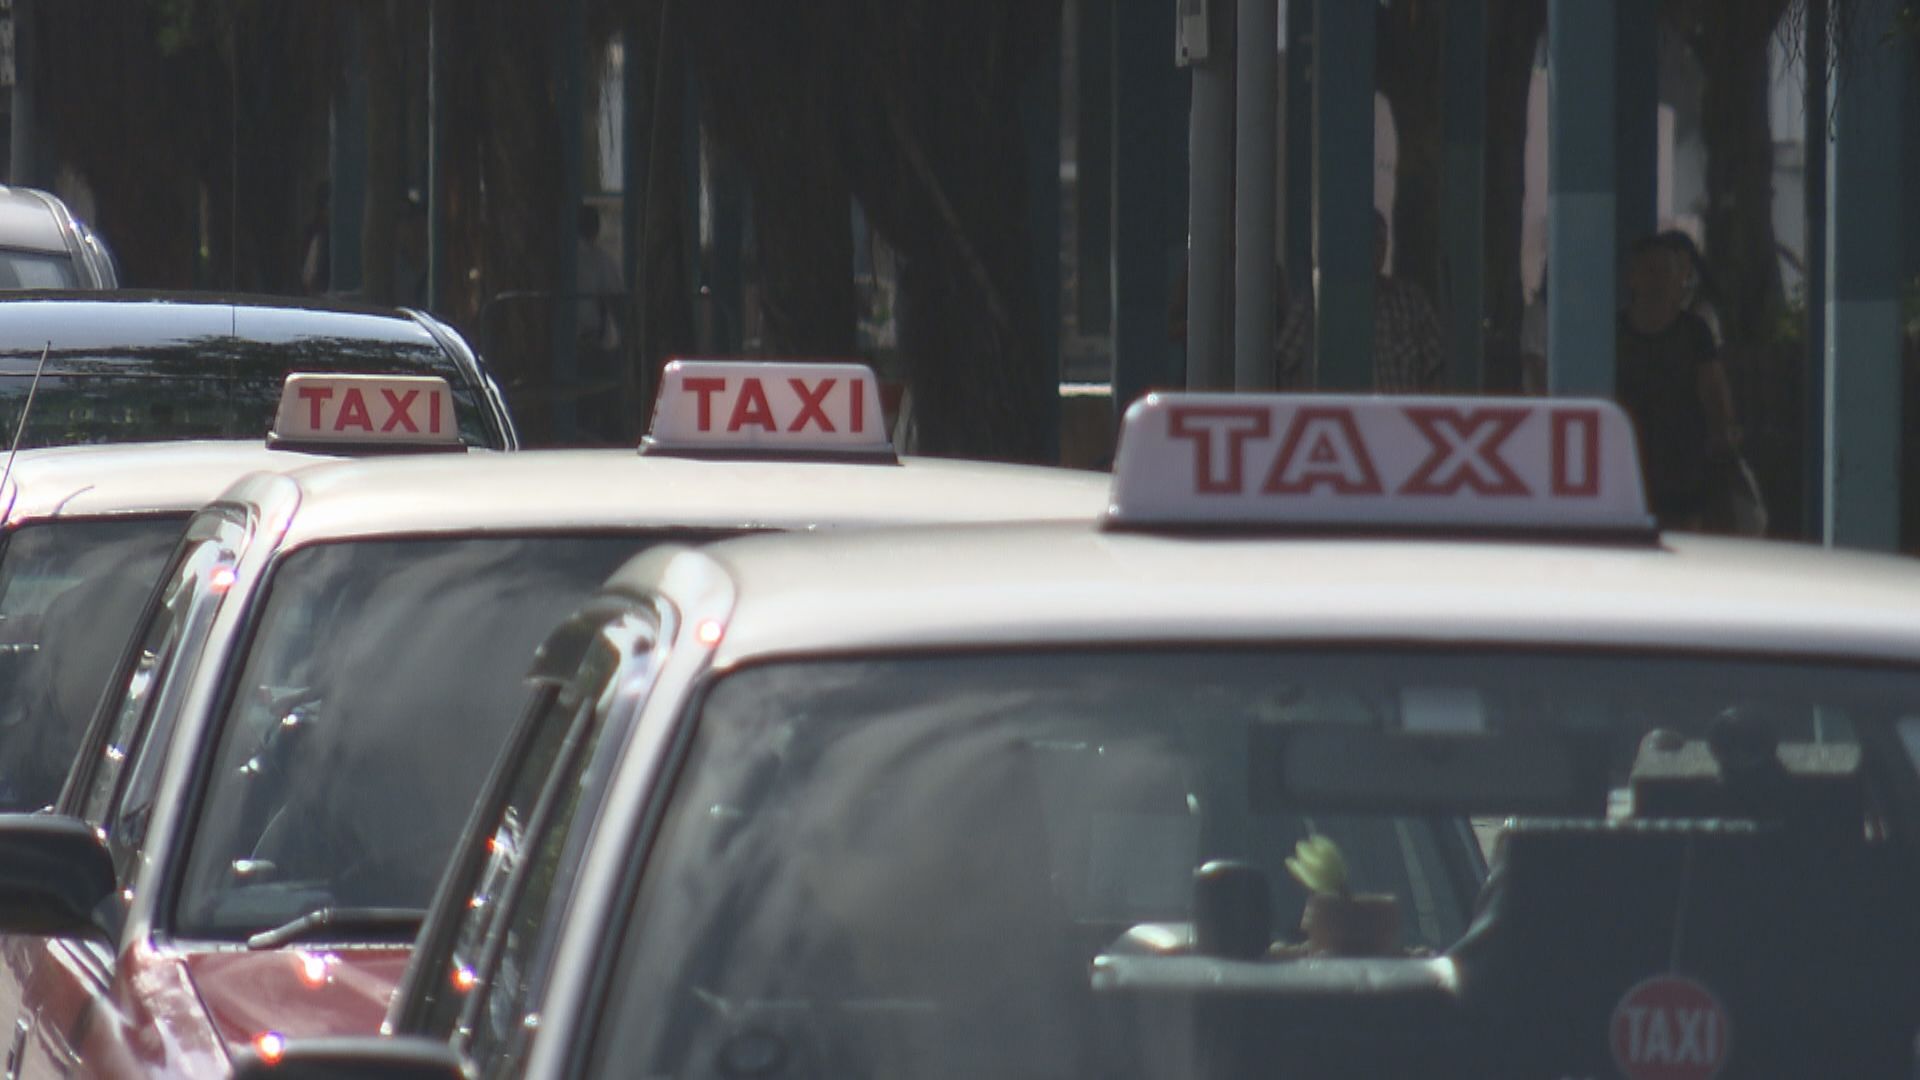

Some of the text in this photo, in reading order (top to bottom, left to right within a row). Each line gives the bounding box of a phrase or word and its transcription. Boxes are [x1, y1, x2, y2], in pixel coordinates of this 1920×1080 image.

[298, 386, 441, 433] TAXI
[682, 377, 864, 433] TAXI
[1166, 407, 1600, 496] TAXI
[1621, 1006, 1717, 1062] TAXI
